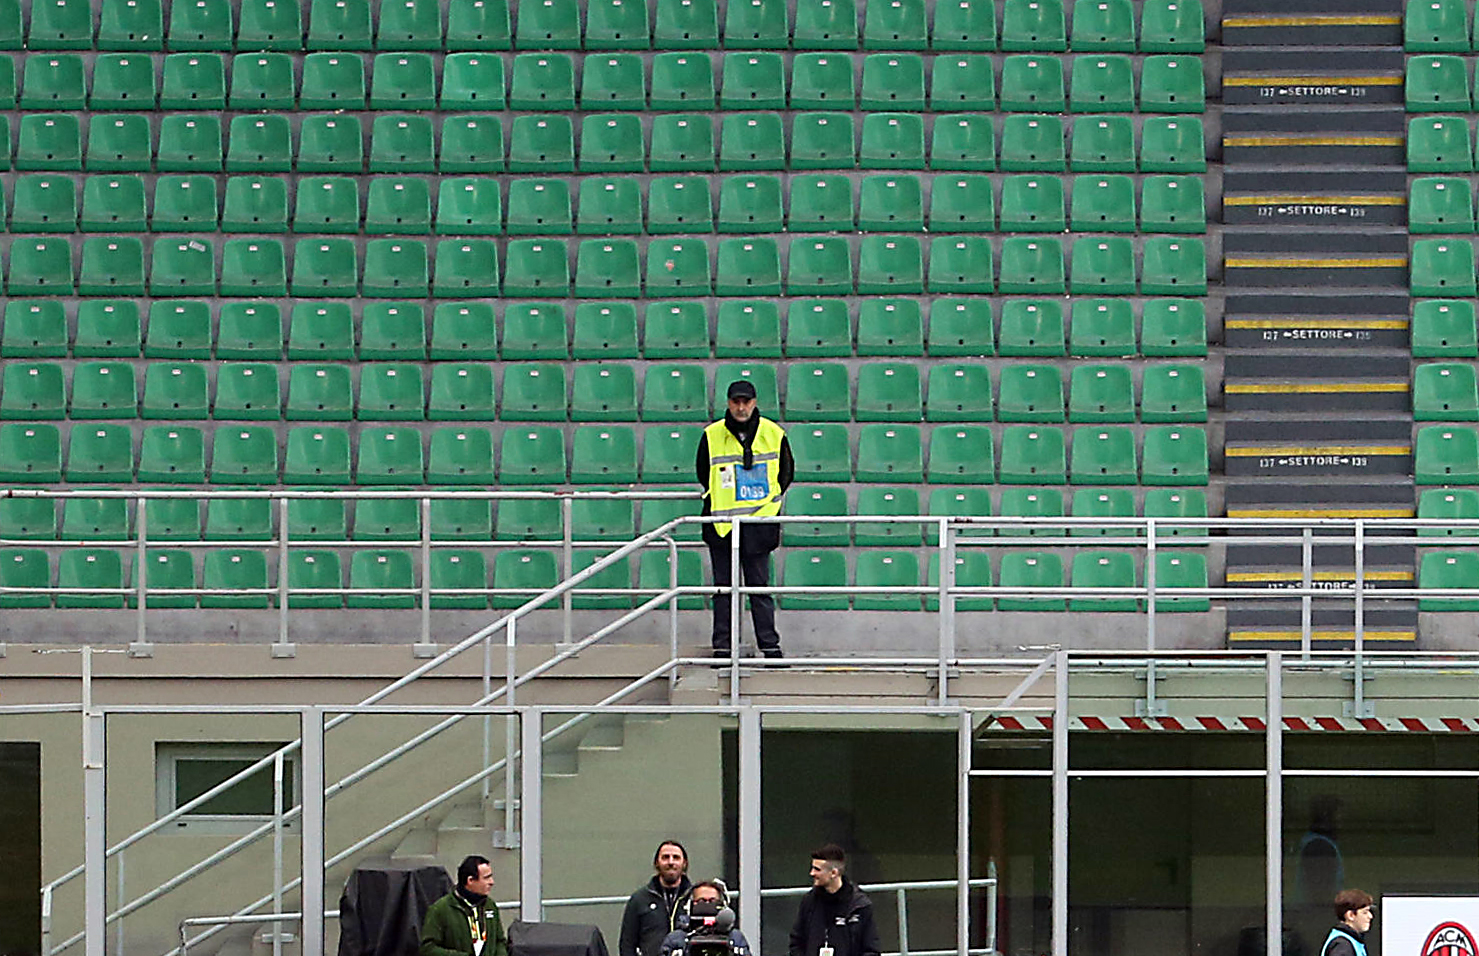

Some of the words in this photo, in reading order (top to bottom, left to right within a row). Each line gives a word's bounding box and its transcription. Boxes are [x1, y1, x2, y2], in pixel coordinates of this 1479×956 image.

[1288, 87, 1338, 96] SETTORE
[1287, 206, 1338, 215] SETTORE
[1292, 330, 1343, 339] SETTORE
[1288, 457, 1340, 466] SETTORE
[1434, 929, 1467, 947] ACM
